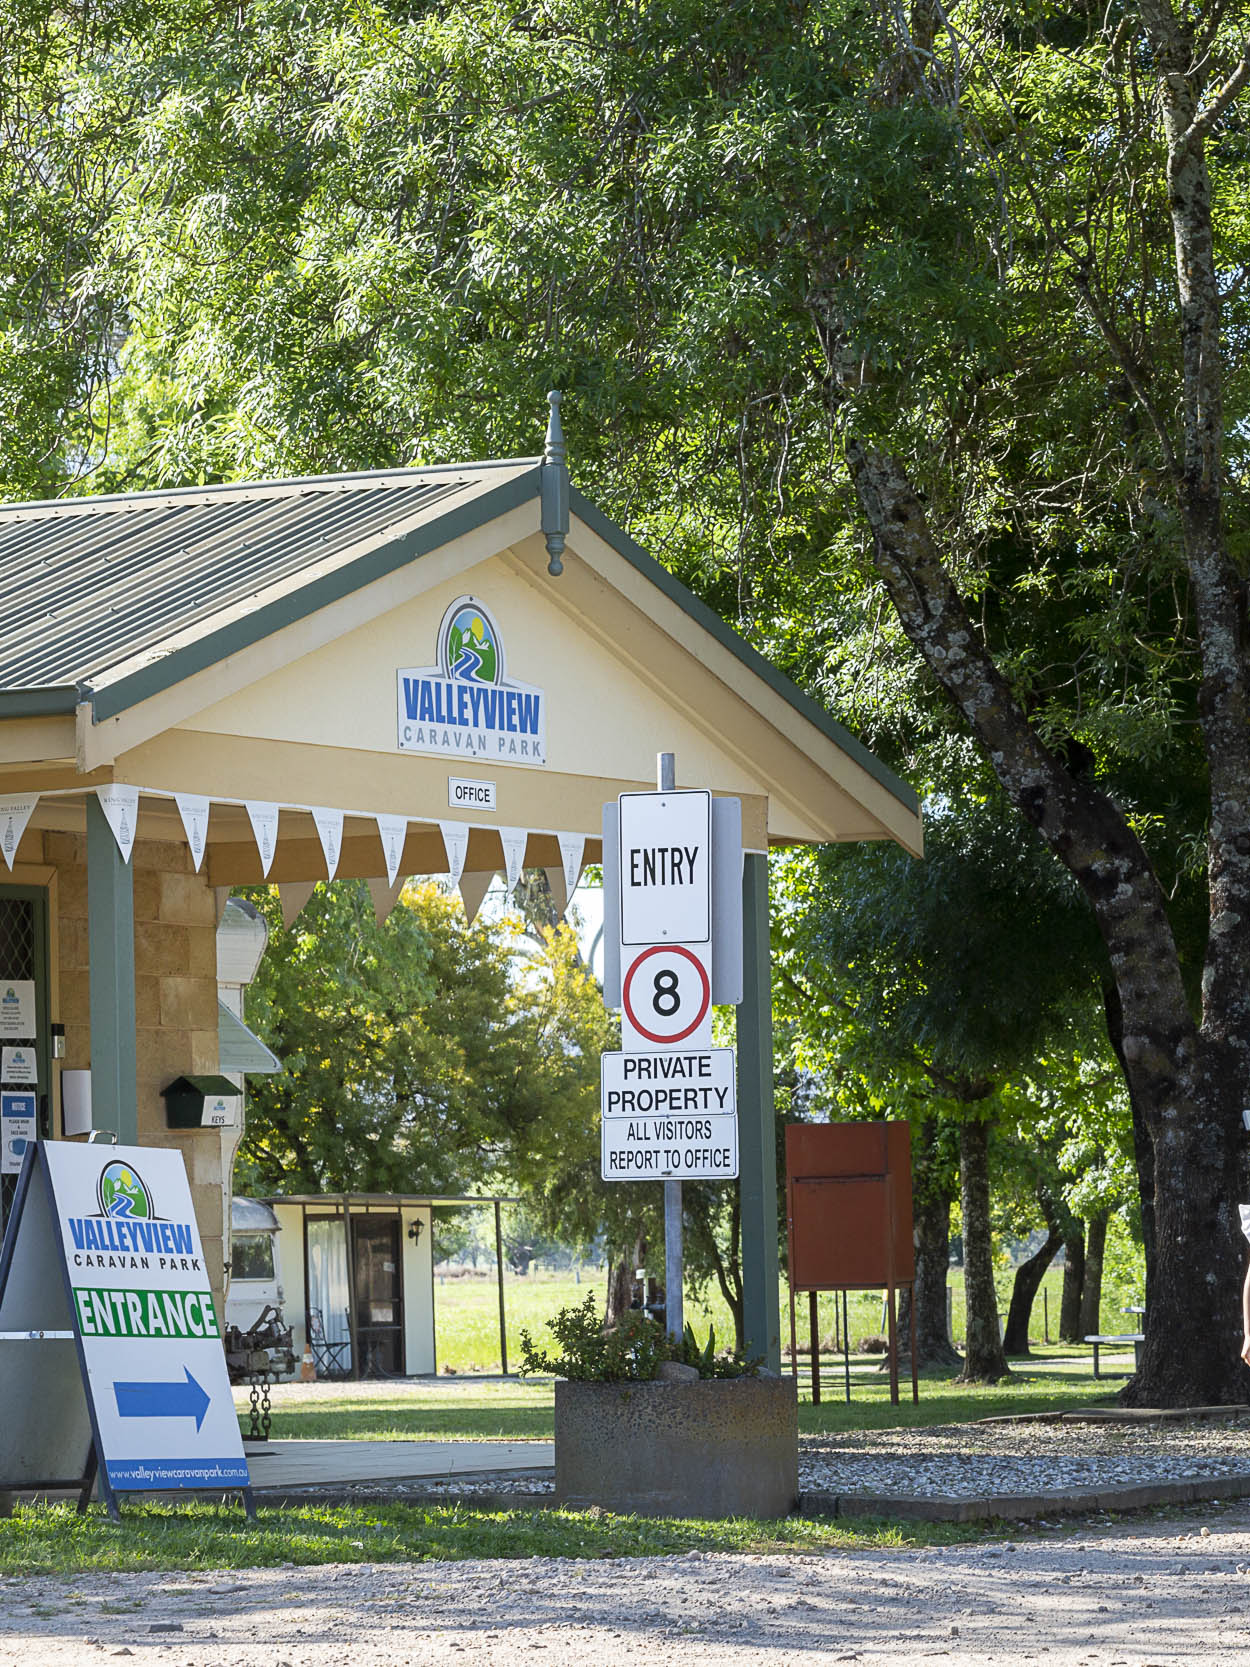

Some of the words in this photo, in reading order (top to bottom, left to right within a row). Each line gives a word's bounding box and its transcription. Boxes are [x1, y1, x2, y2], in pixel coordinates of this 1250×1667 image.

[403, 677, 540, 735] VALLEYVIEW
[403, 726, 487, 751] CARAVAN
[498, 737, 541, 757] PARK
[455, 786, 490, 802] OFFICE
[630, 846, 699, 887] ENTRY
[652, 969, 680, 1016] 8
[623, 1055, 712, 1080] PRIVATE
[607, 1087, 728, 1112] PROPERTY
[211, 1116, 225, 1124] KEYS
[627, 1122, 651, 1141] ALL
[654, 1120, 712, 1140] VISITORS
[610, 1150, 660, 1170] REPORT
[664, 1149, 681, 1168] TO
[685, 1148, 731, 1169] OFFICE
[68, 1218, 194, 1254] VALLEYVIEW
[73, 1254, 150, 1269] CARAVAN
[160, 1258, 201, 1271] PARK
[76, 1289, 218, 1336] ENTRANCE
[109, 1464, 248, 1482] www.valleyviewcaravanpark.com.au
